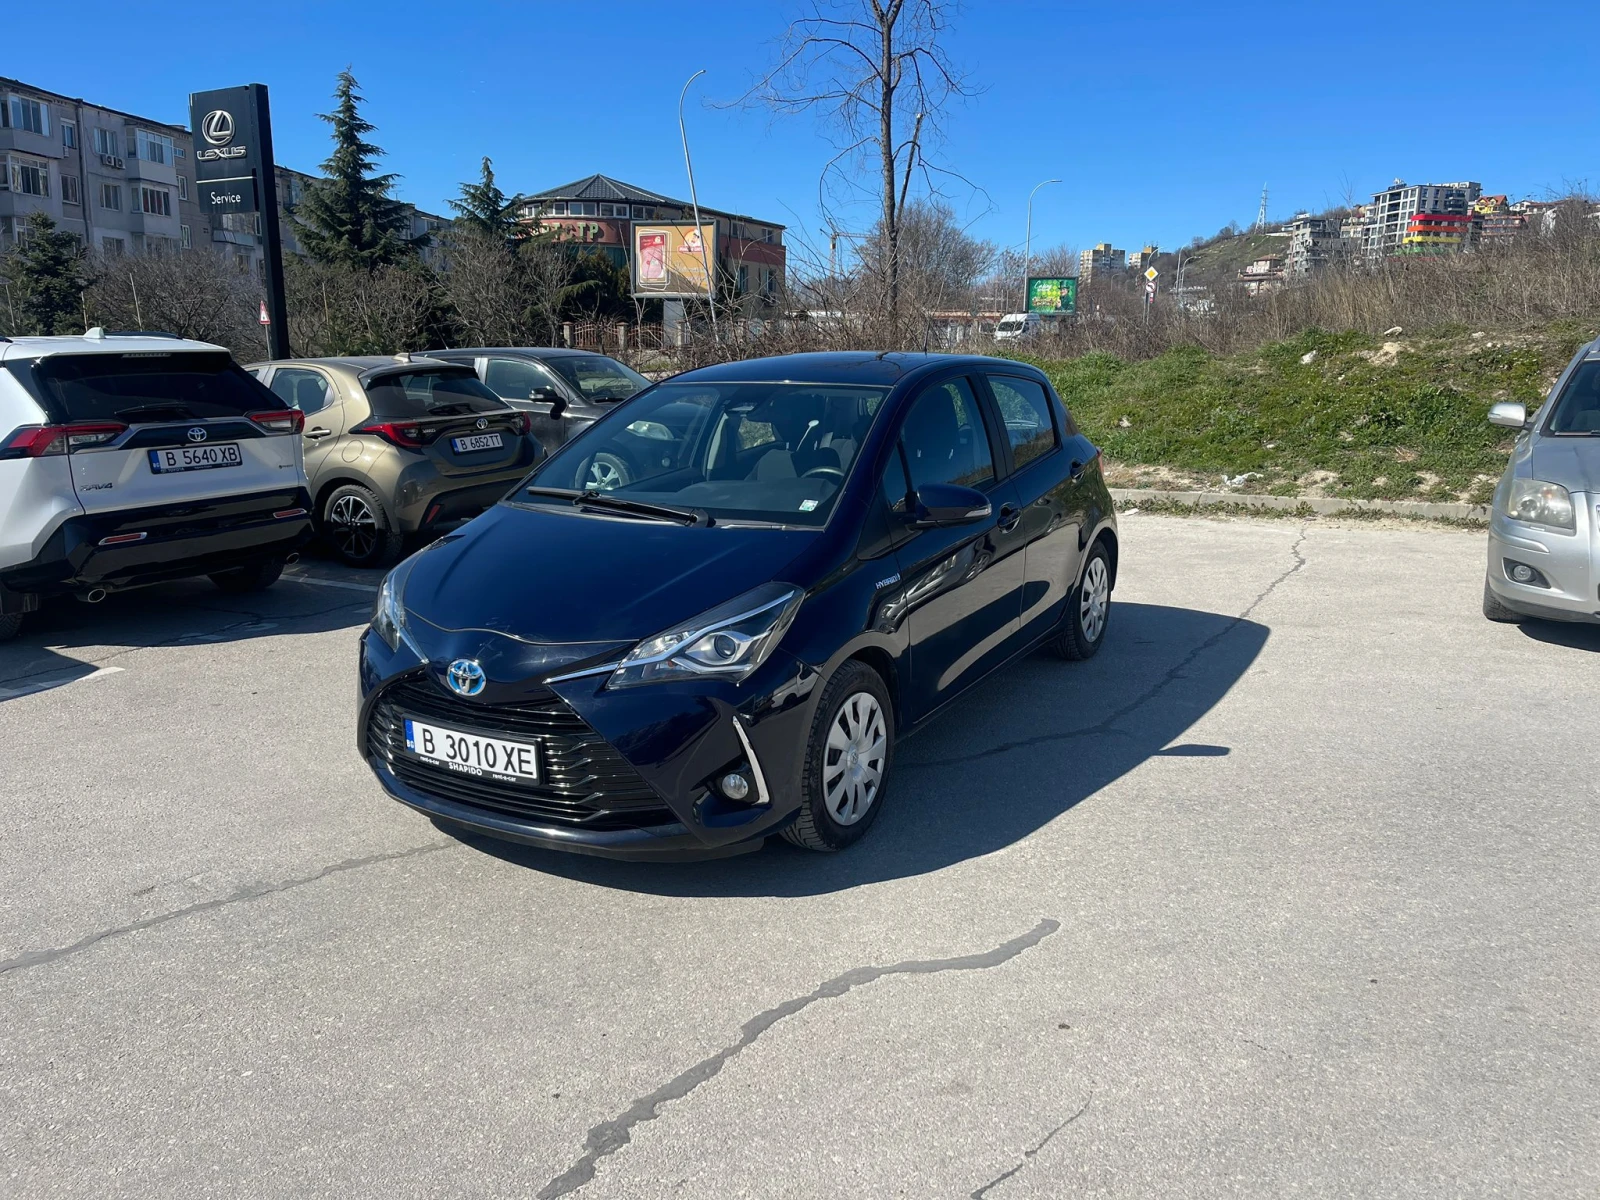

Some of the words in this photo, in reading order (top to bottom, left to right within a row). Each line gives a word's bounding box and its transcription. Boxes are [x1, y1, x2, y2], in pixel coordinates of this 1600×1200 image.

[197, 145, 246, 160] LEXUS
[210, 191, 241, 205] Service
[460, 439, 468, 450] B
[470, 436, 490, 449] 6852
[489, 434, 500, 446] TT
[165, 451, 177, 467] B
[182, 448, 218, 465] 5640
[219, 447, 238, 463] XB
[406, 739, 415, 748] BG
[422, 728, 435, 755] B
[445, 734, 497, 769] 3010
[502, 745, 534, 776] XE
[448, 762, 483, 776] SHAPIDO
